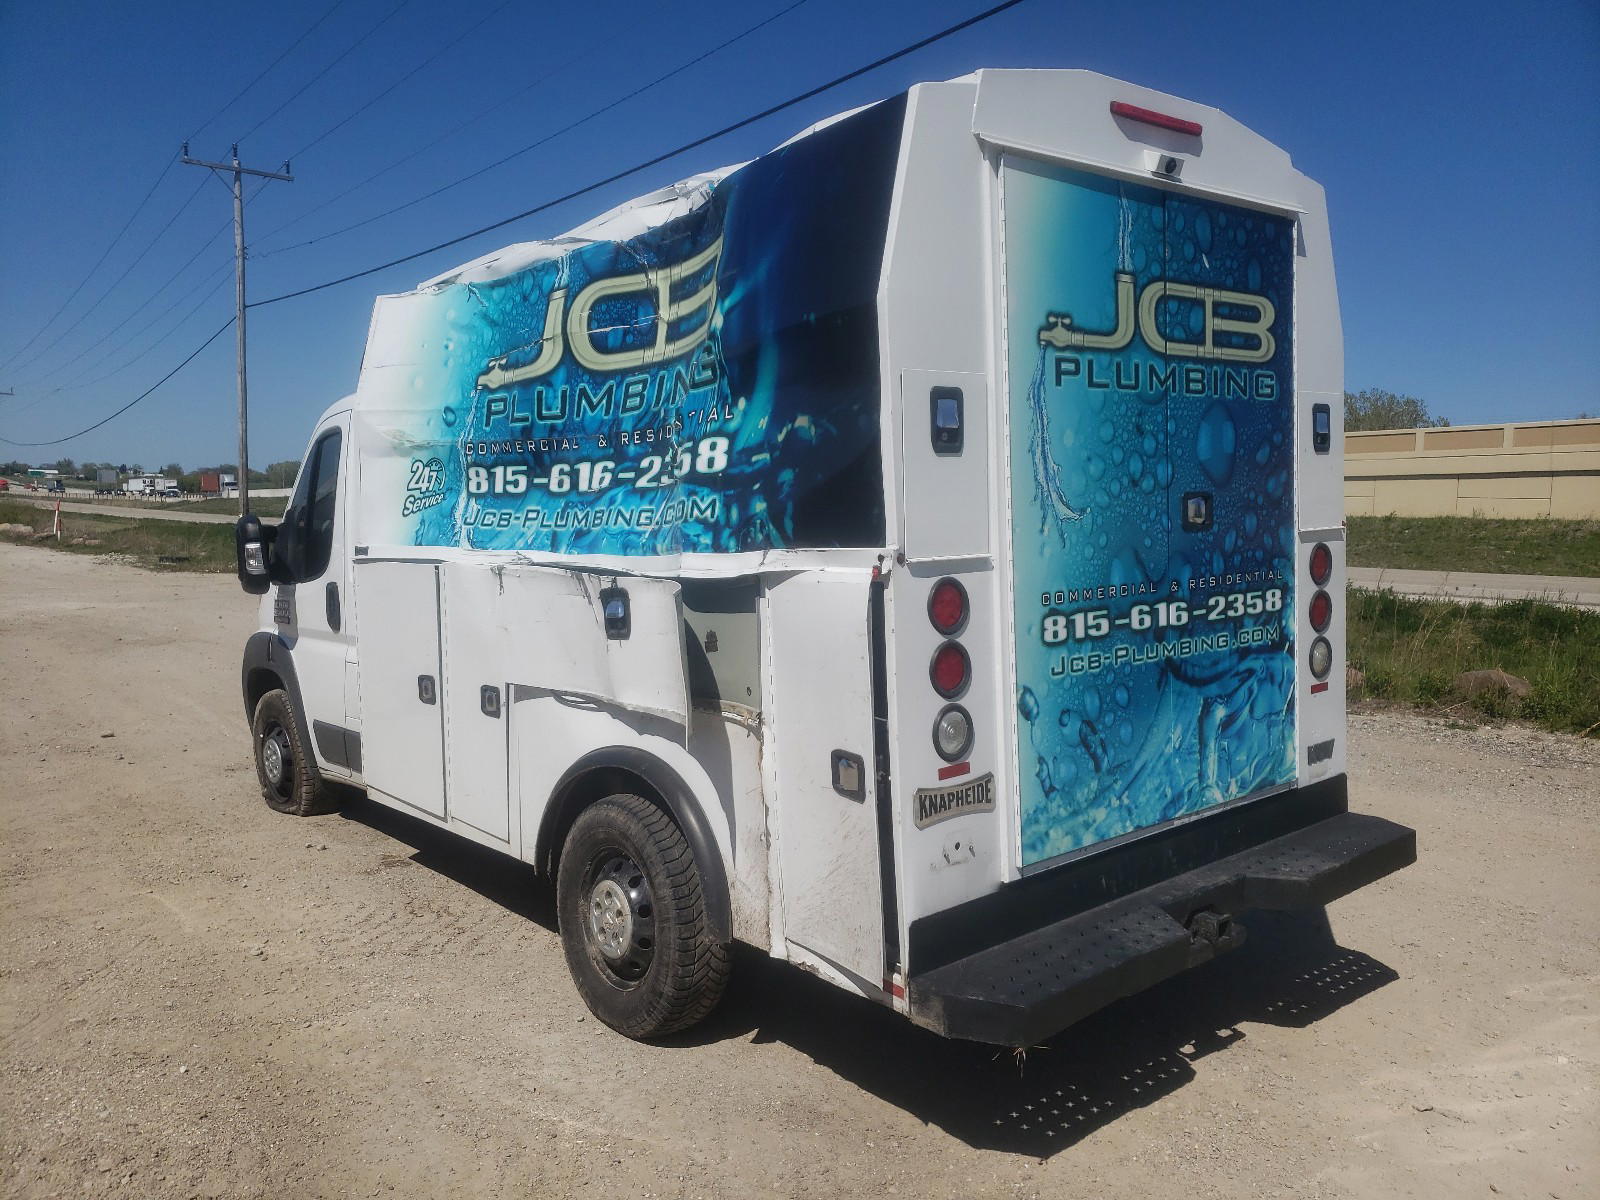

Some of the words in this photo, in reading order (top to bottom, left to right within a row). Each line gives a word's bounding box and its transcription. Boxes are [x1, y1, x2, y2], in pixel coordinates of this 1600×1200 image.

[1039, 272, 1276, 363] JCB
[1053, 353, 1277, 400] PLUMBING
[465, 436, 579, 455] COMMERCIAL
[598, 434, 607, 447] &
[402, 493, 446, 517] Service
[1042, 581, 1157, 605] COMMERCIAL
[1170, 581, 1178, 592] &
[1189, 568, 1283, 590] RESIDENTIAL
[1043, 588, 1282, 643] 815-616-2358
[919, 777, 992, 821] KNAPHEIDE
